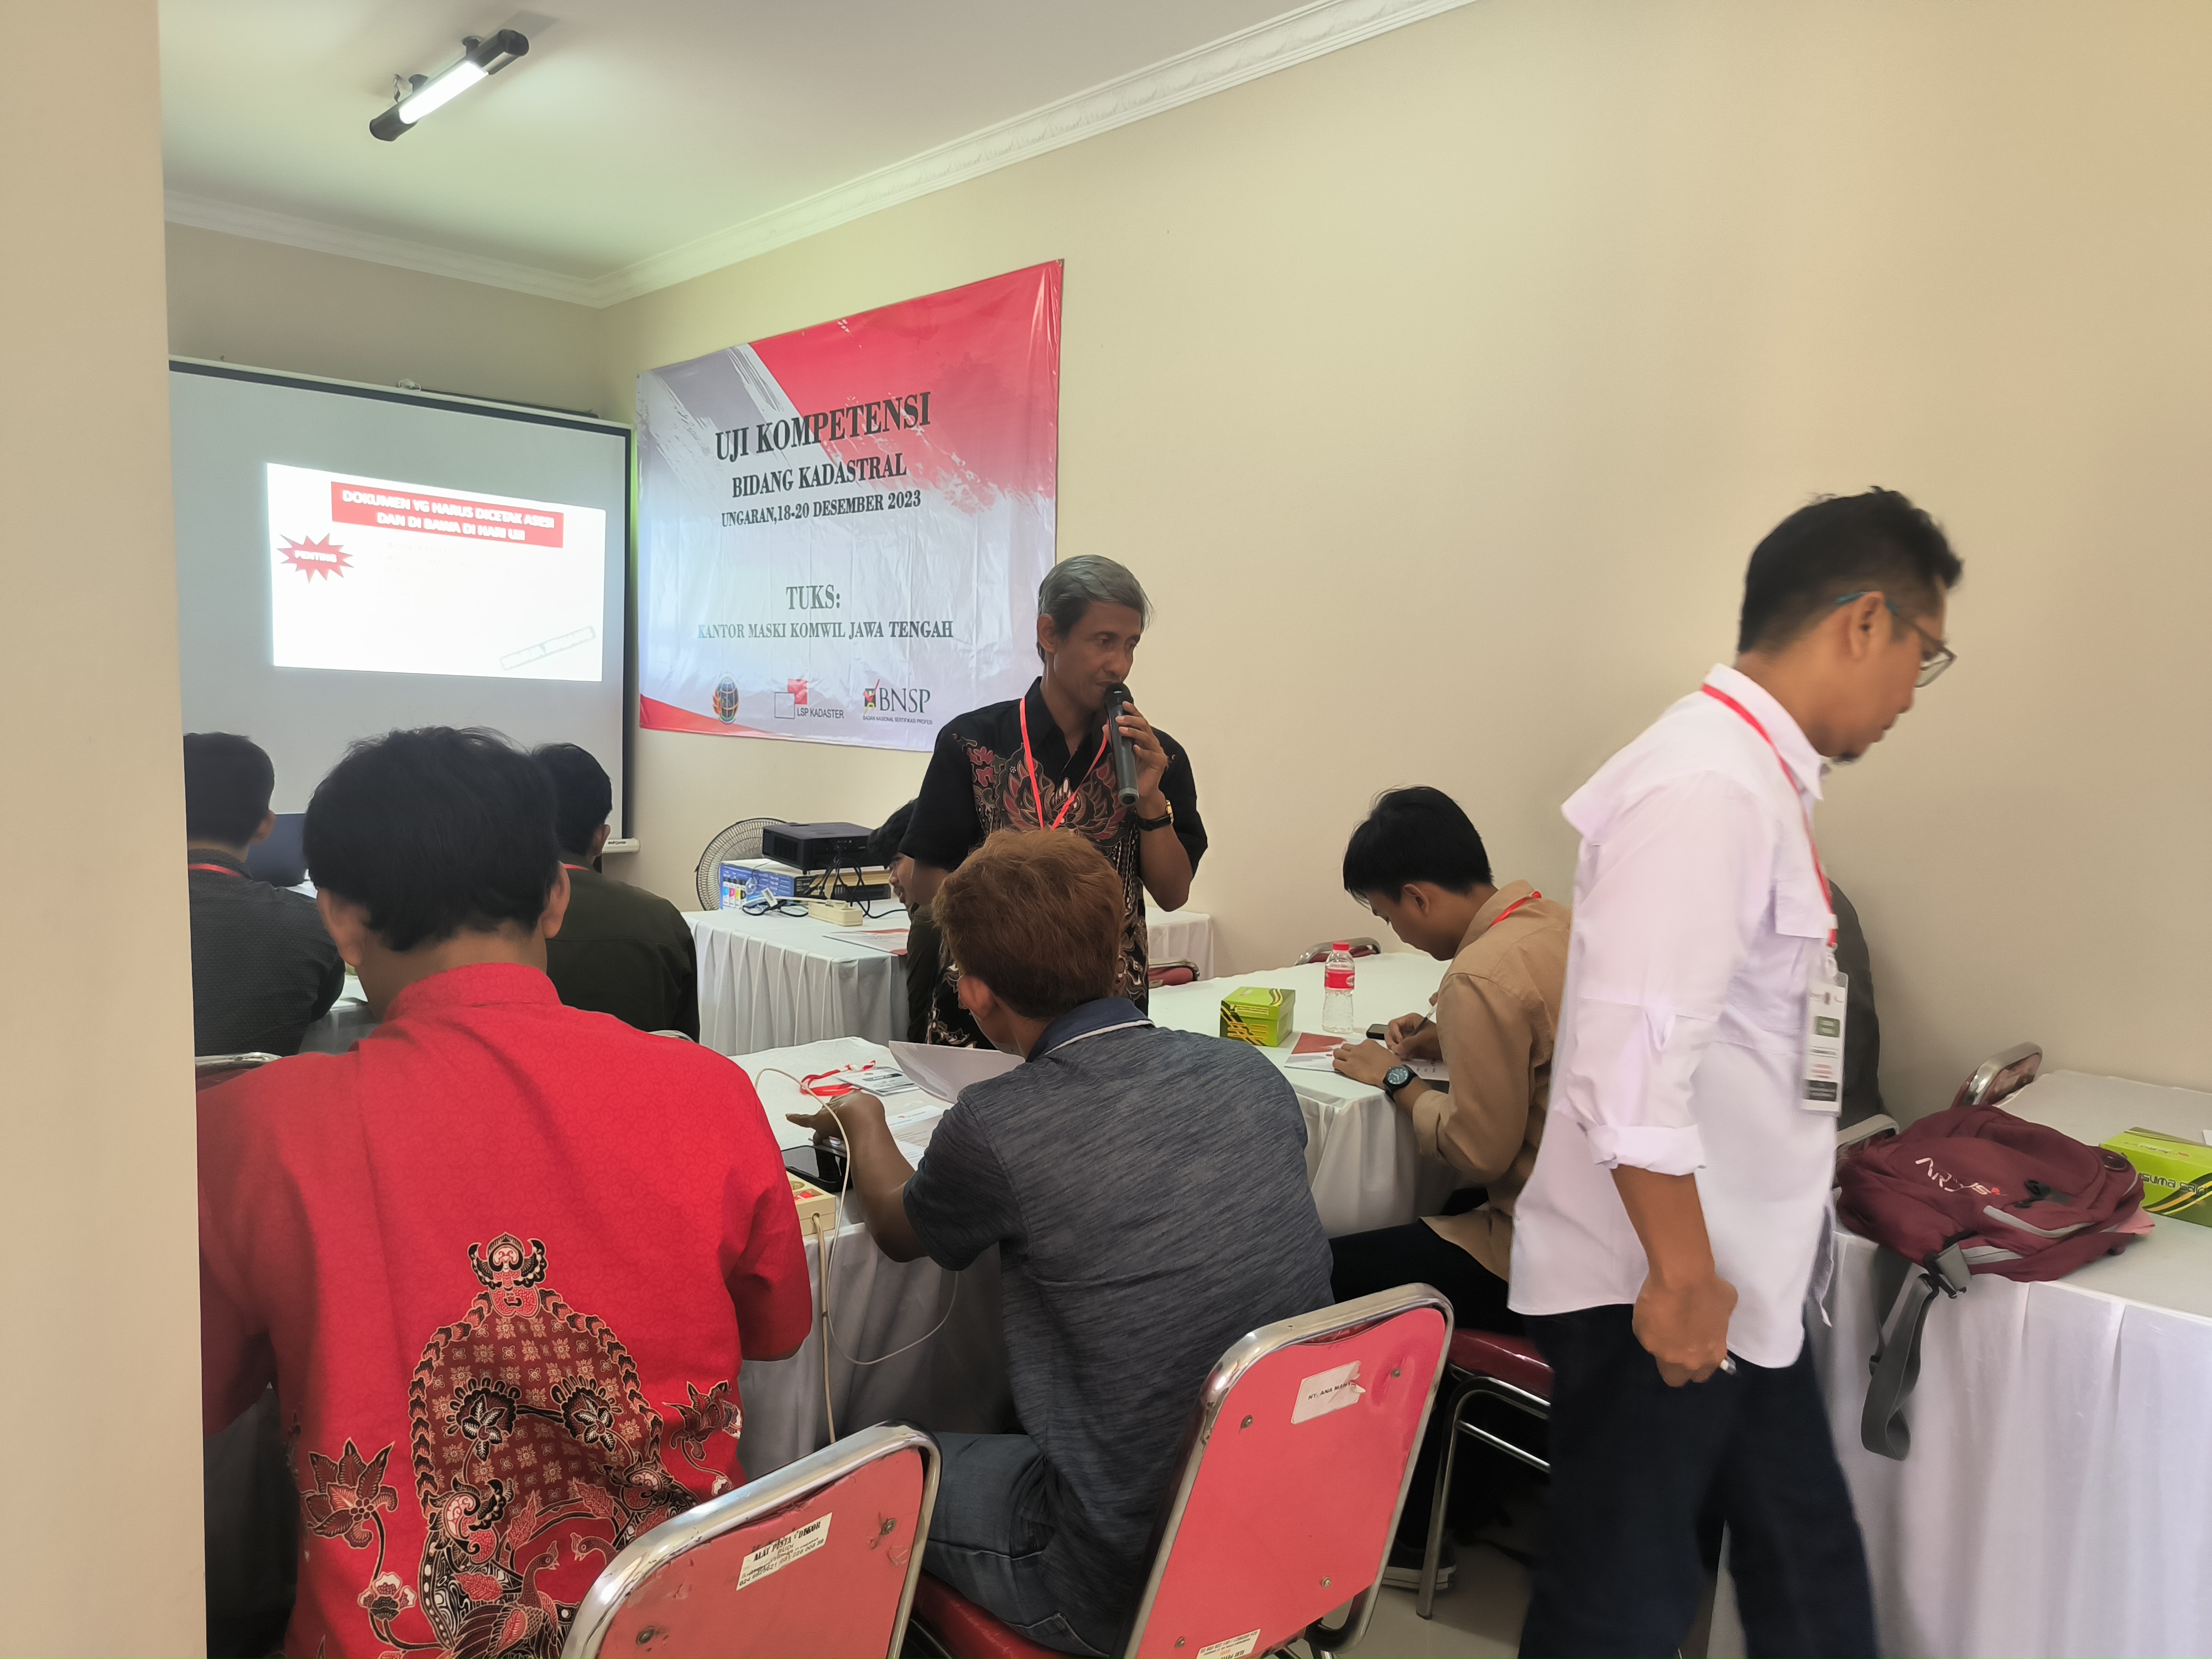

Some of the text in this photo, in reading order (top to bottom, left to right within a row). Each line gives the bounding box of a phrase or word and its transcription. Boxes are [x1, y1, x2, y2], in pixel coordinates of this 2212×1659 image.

[715, 392, 931, 462] UJI KOMPETENSI
[732, 453, 907, 498] BIDANG KADASTRAL
[342, 489, 411, 510] DOKUMEN
[413, 499, 430, 513] YG
[432, 502, 473, 518] HARUS
[475, 507, 523, 524] DICETAK
[721, 489, 921, 527] UNGARAN,18-20 DESEMBER 2023
[377, 512, 405, 526] DAN
[408, 515, 421, 528] DI
[462, 523, 476, 535] DI
[786, 584, 840, 610] TUKS:
[698, 620, 953, 640] KANTOR MASKI KOMWIL JAWA TENGAH
[797, 707, 844, 719] LSP KADASTER
[879, 687, 931, 713] BNSP
[1320, 1387, 1333, 1396] ANA
[753, 1546, 771, 1562] ALAT
